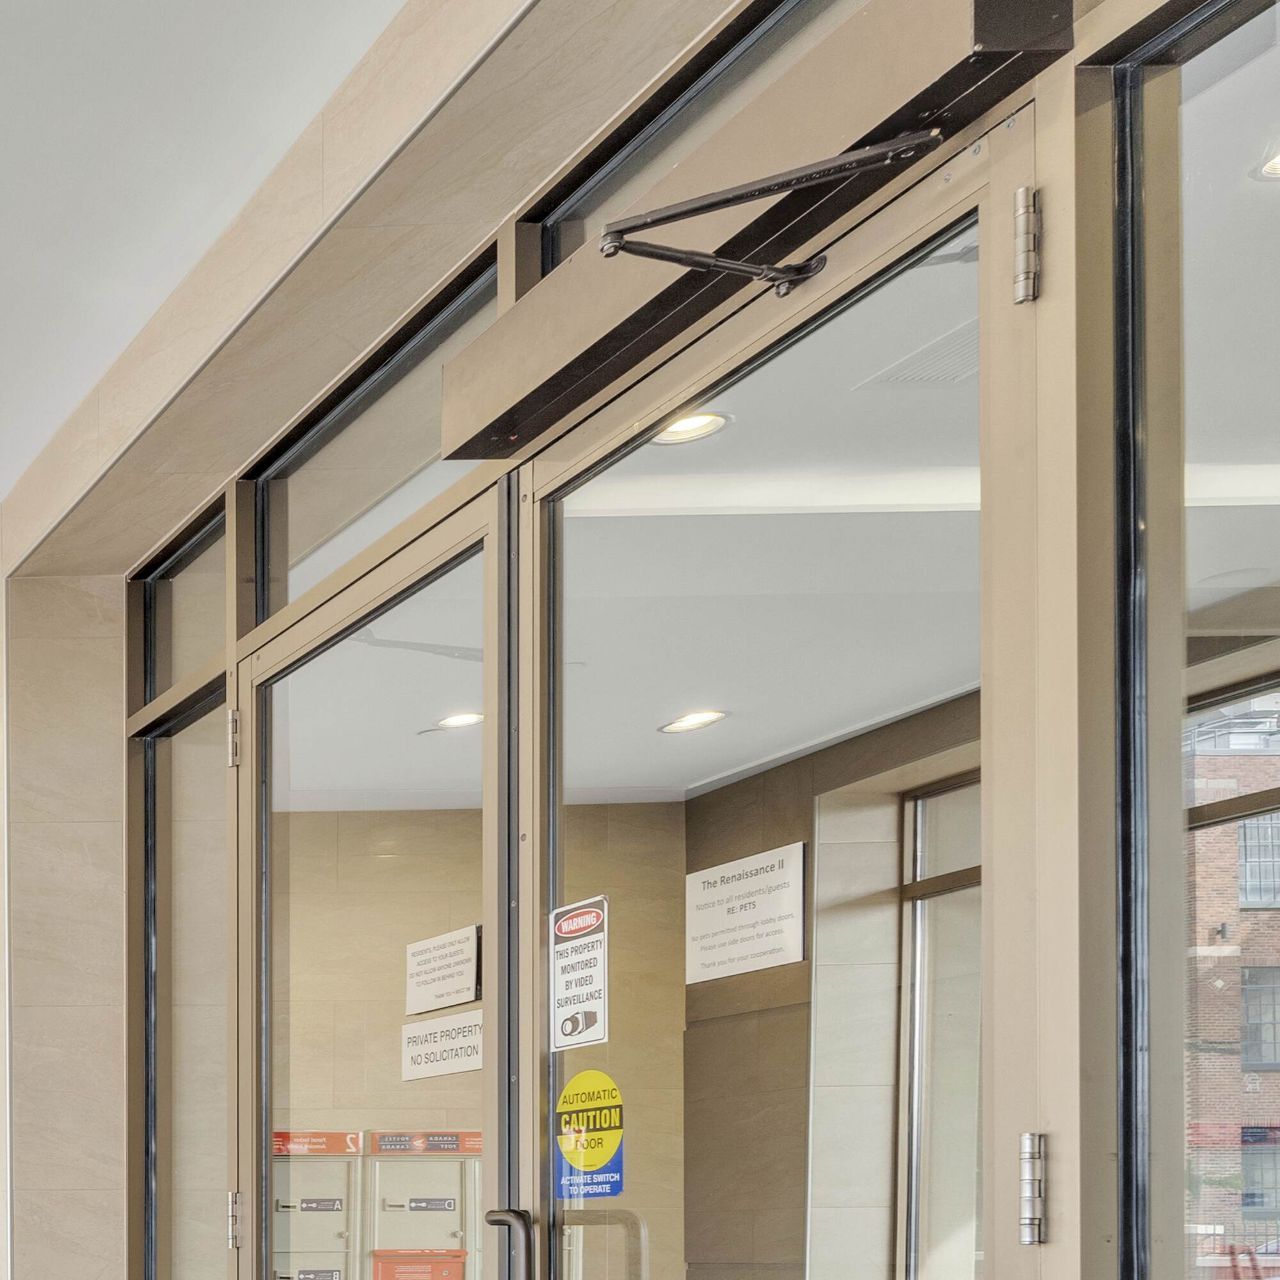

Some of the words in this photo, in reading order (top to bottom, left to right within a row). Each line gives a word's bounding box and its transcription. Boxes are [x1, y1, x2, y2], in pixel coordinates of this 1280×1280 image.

[702, 880, 718, 891] The
[720, 864, 775, 886] Renaissance
[778, 859, 784, 870] II
[696, 901, 715, 911] Notice
[734, 880, 790, 902] residents/guests
[727, 906, 737, 915] RE:
[740, 901, 756, 912] PETS
[561, 913, 596, 933] WARNING
[556, 948, 569, 960] THIS
[570, 940, 603, 957] PROPERTY
[561, 957, 597, 975] MONITORED
[565, 980, 573, 990] BY
[575, 975, 593, 988] VIDEO
[557, 989, 602, 1008] SURVEILLANCE
[407, 1032, 438, 1048] PRIVATE
[441, 1024, 483, 1041] PROPERTY
[411, 1054, 422, 1066] NO
[425, 1044, 479, 1064] SOLICITATION
[562, 1088, 617, 1105] AUTOMATIC
[561, 1108, 620, 1132] CAUTION
[576, 1138, 603, 1149] DOOR
[561, 1175, 592, 1184] ACTIVATE
[593, 1173, 620, 1183] SWITCH
[569, 1186, 578, 1194] TO
[580, 1184, 611, 1193] OPERATE
